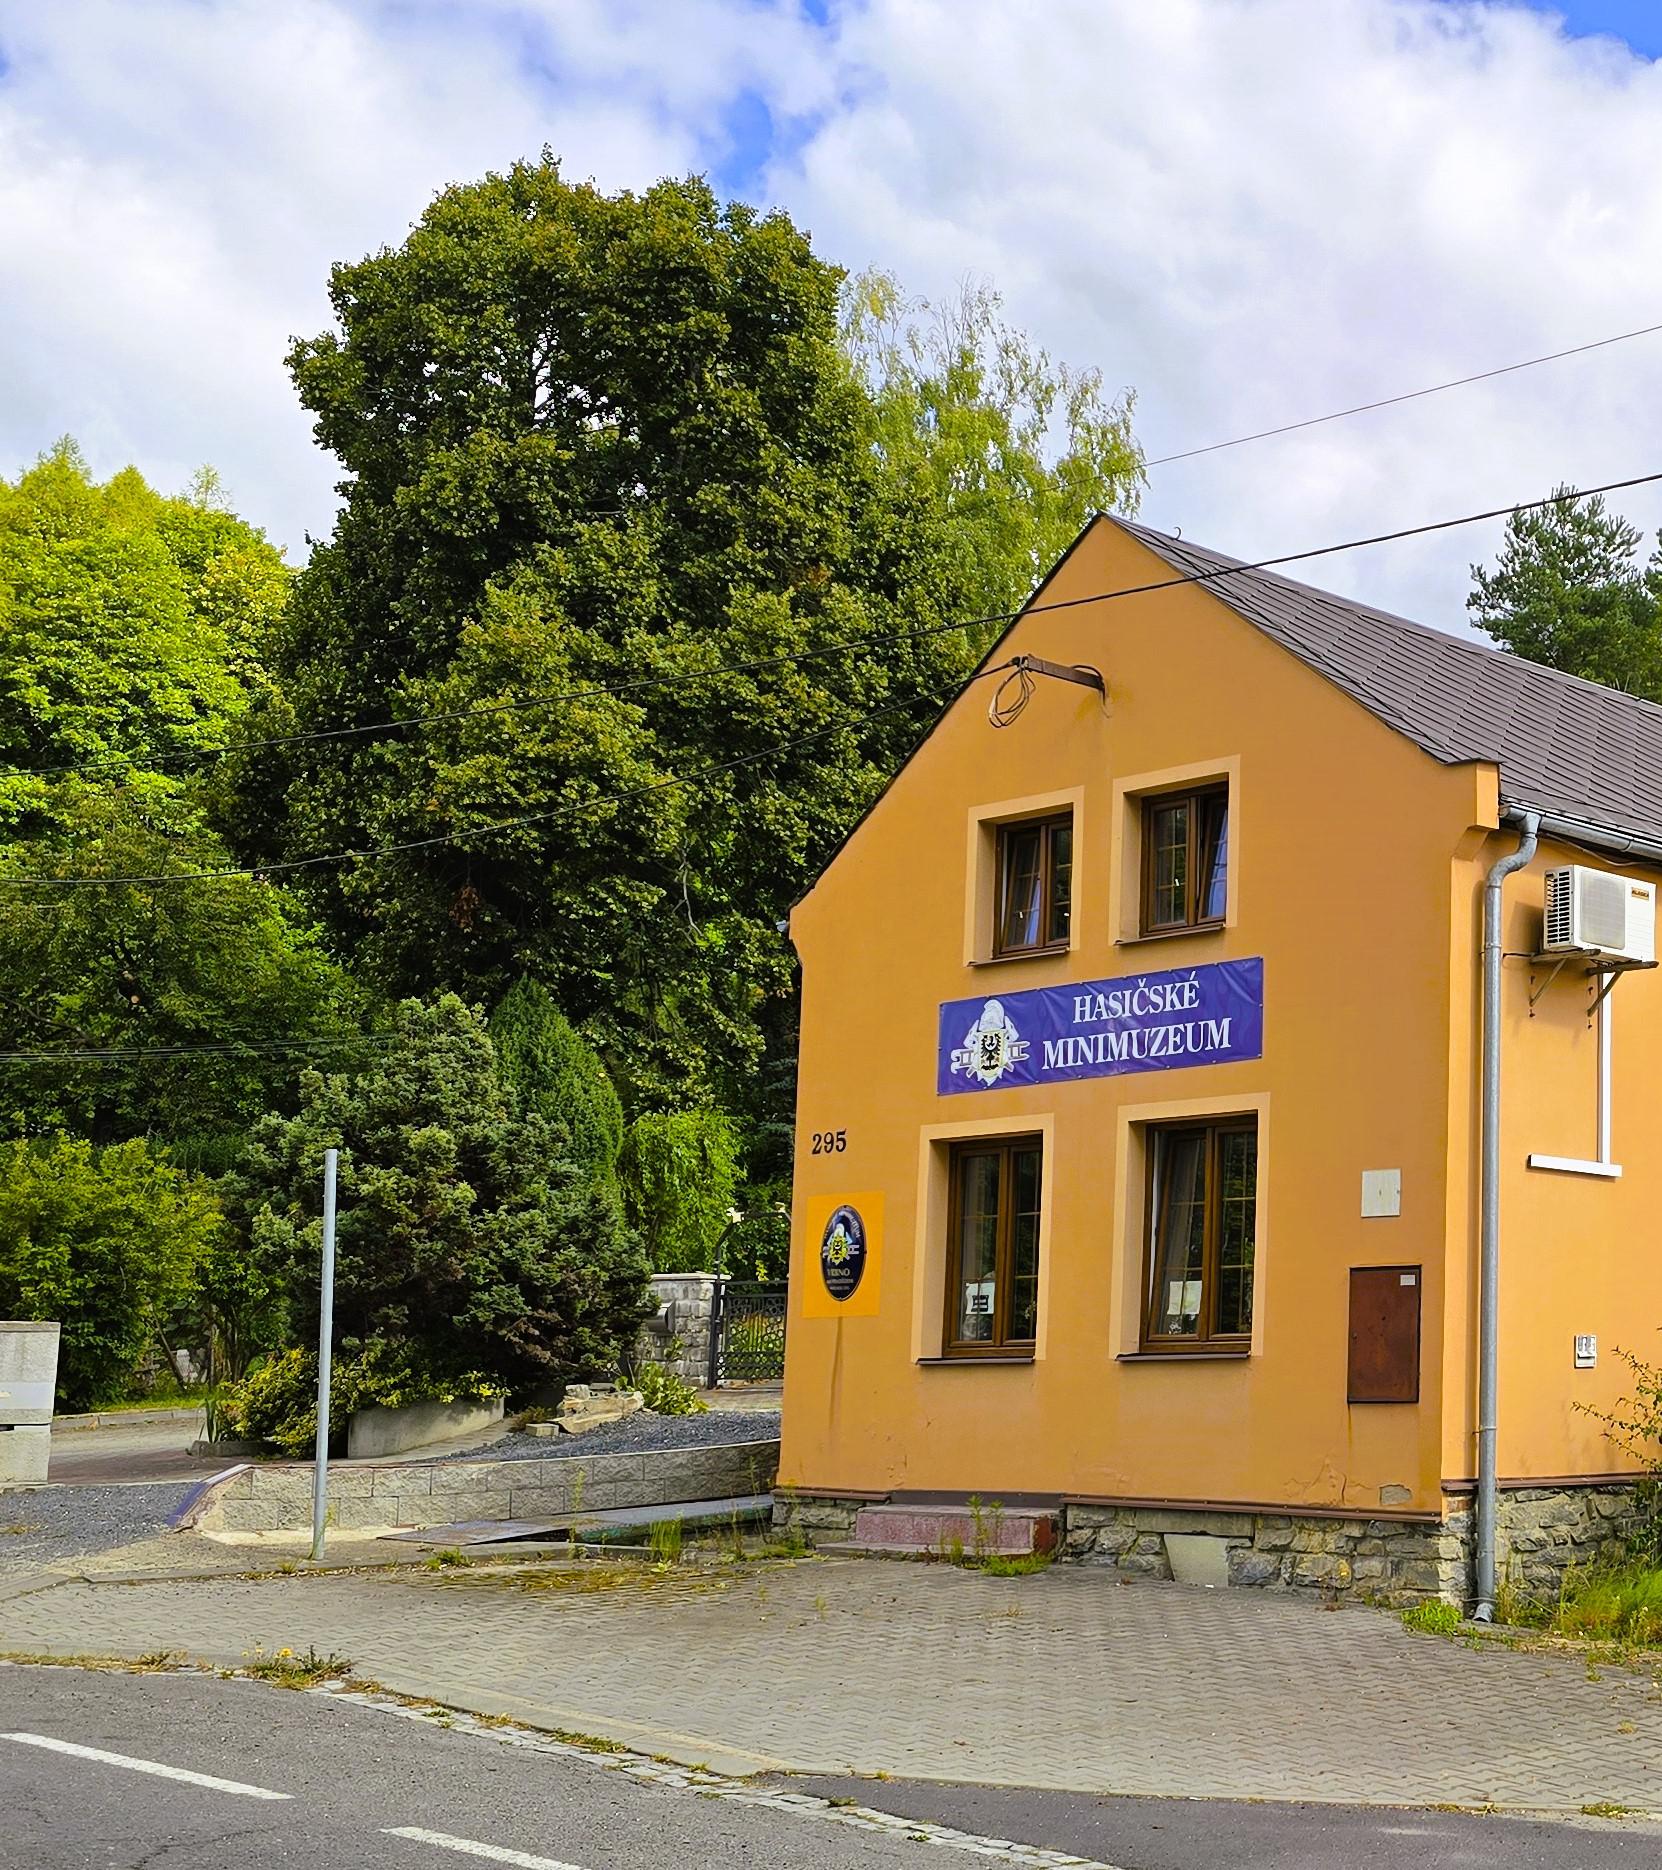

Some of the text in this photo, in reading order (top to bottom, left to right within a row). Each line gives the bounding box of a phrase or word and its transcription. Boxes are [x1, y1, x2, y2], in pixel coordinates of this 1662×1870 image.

[1072, 971, 1200, 1023] HASIČSKÉ
[1041, 1017, 1232, 1070] MINIMUZEUM
[812, 1128, 847, 1154] 295
